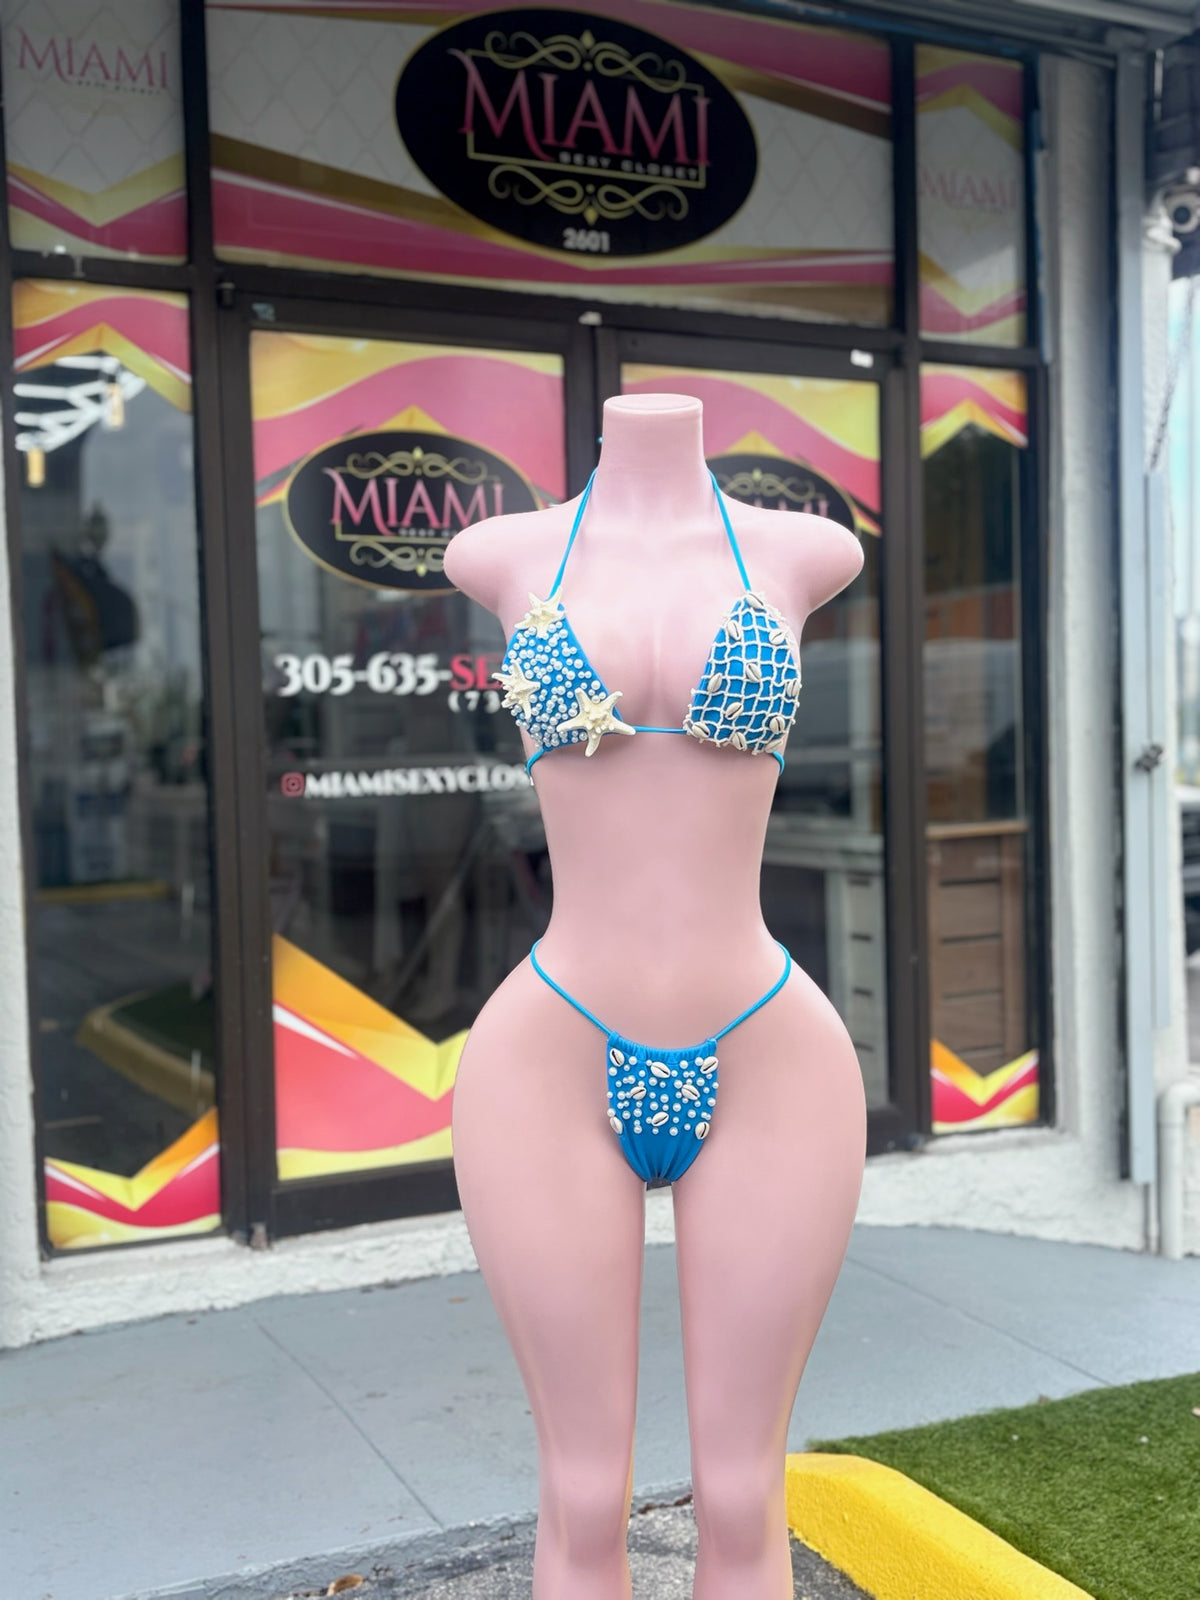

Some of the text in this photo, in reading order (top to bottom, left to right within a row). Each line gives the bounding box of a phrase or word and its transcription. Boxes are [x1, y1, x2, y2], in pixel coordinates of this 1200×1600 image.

[16, 24, 168, 89] MIAMI
[448, 48, 711, 167] MIAMI
[563, 227, 610, 253] 2601
[321, 467, 506, 536] MIAMI
